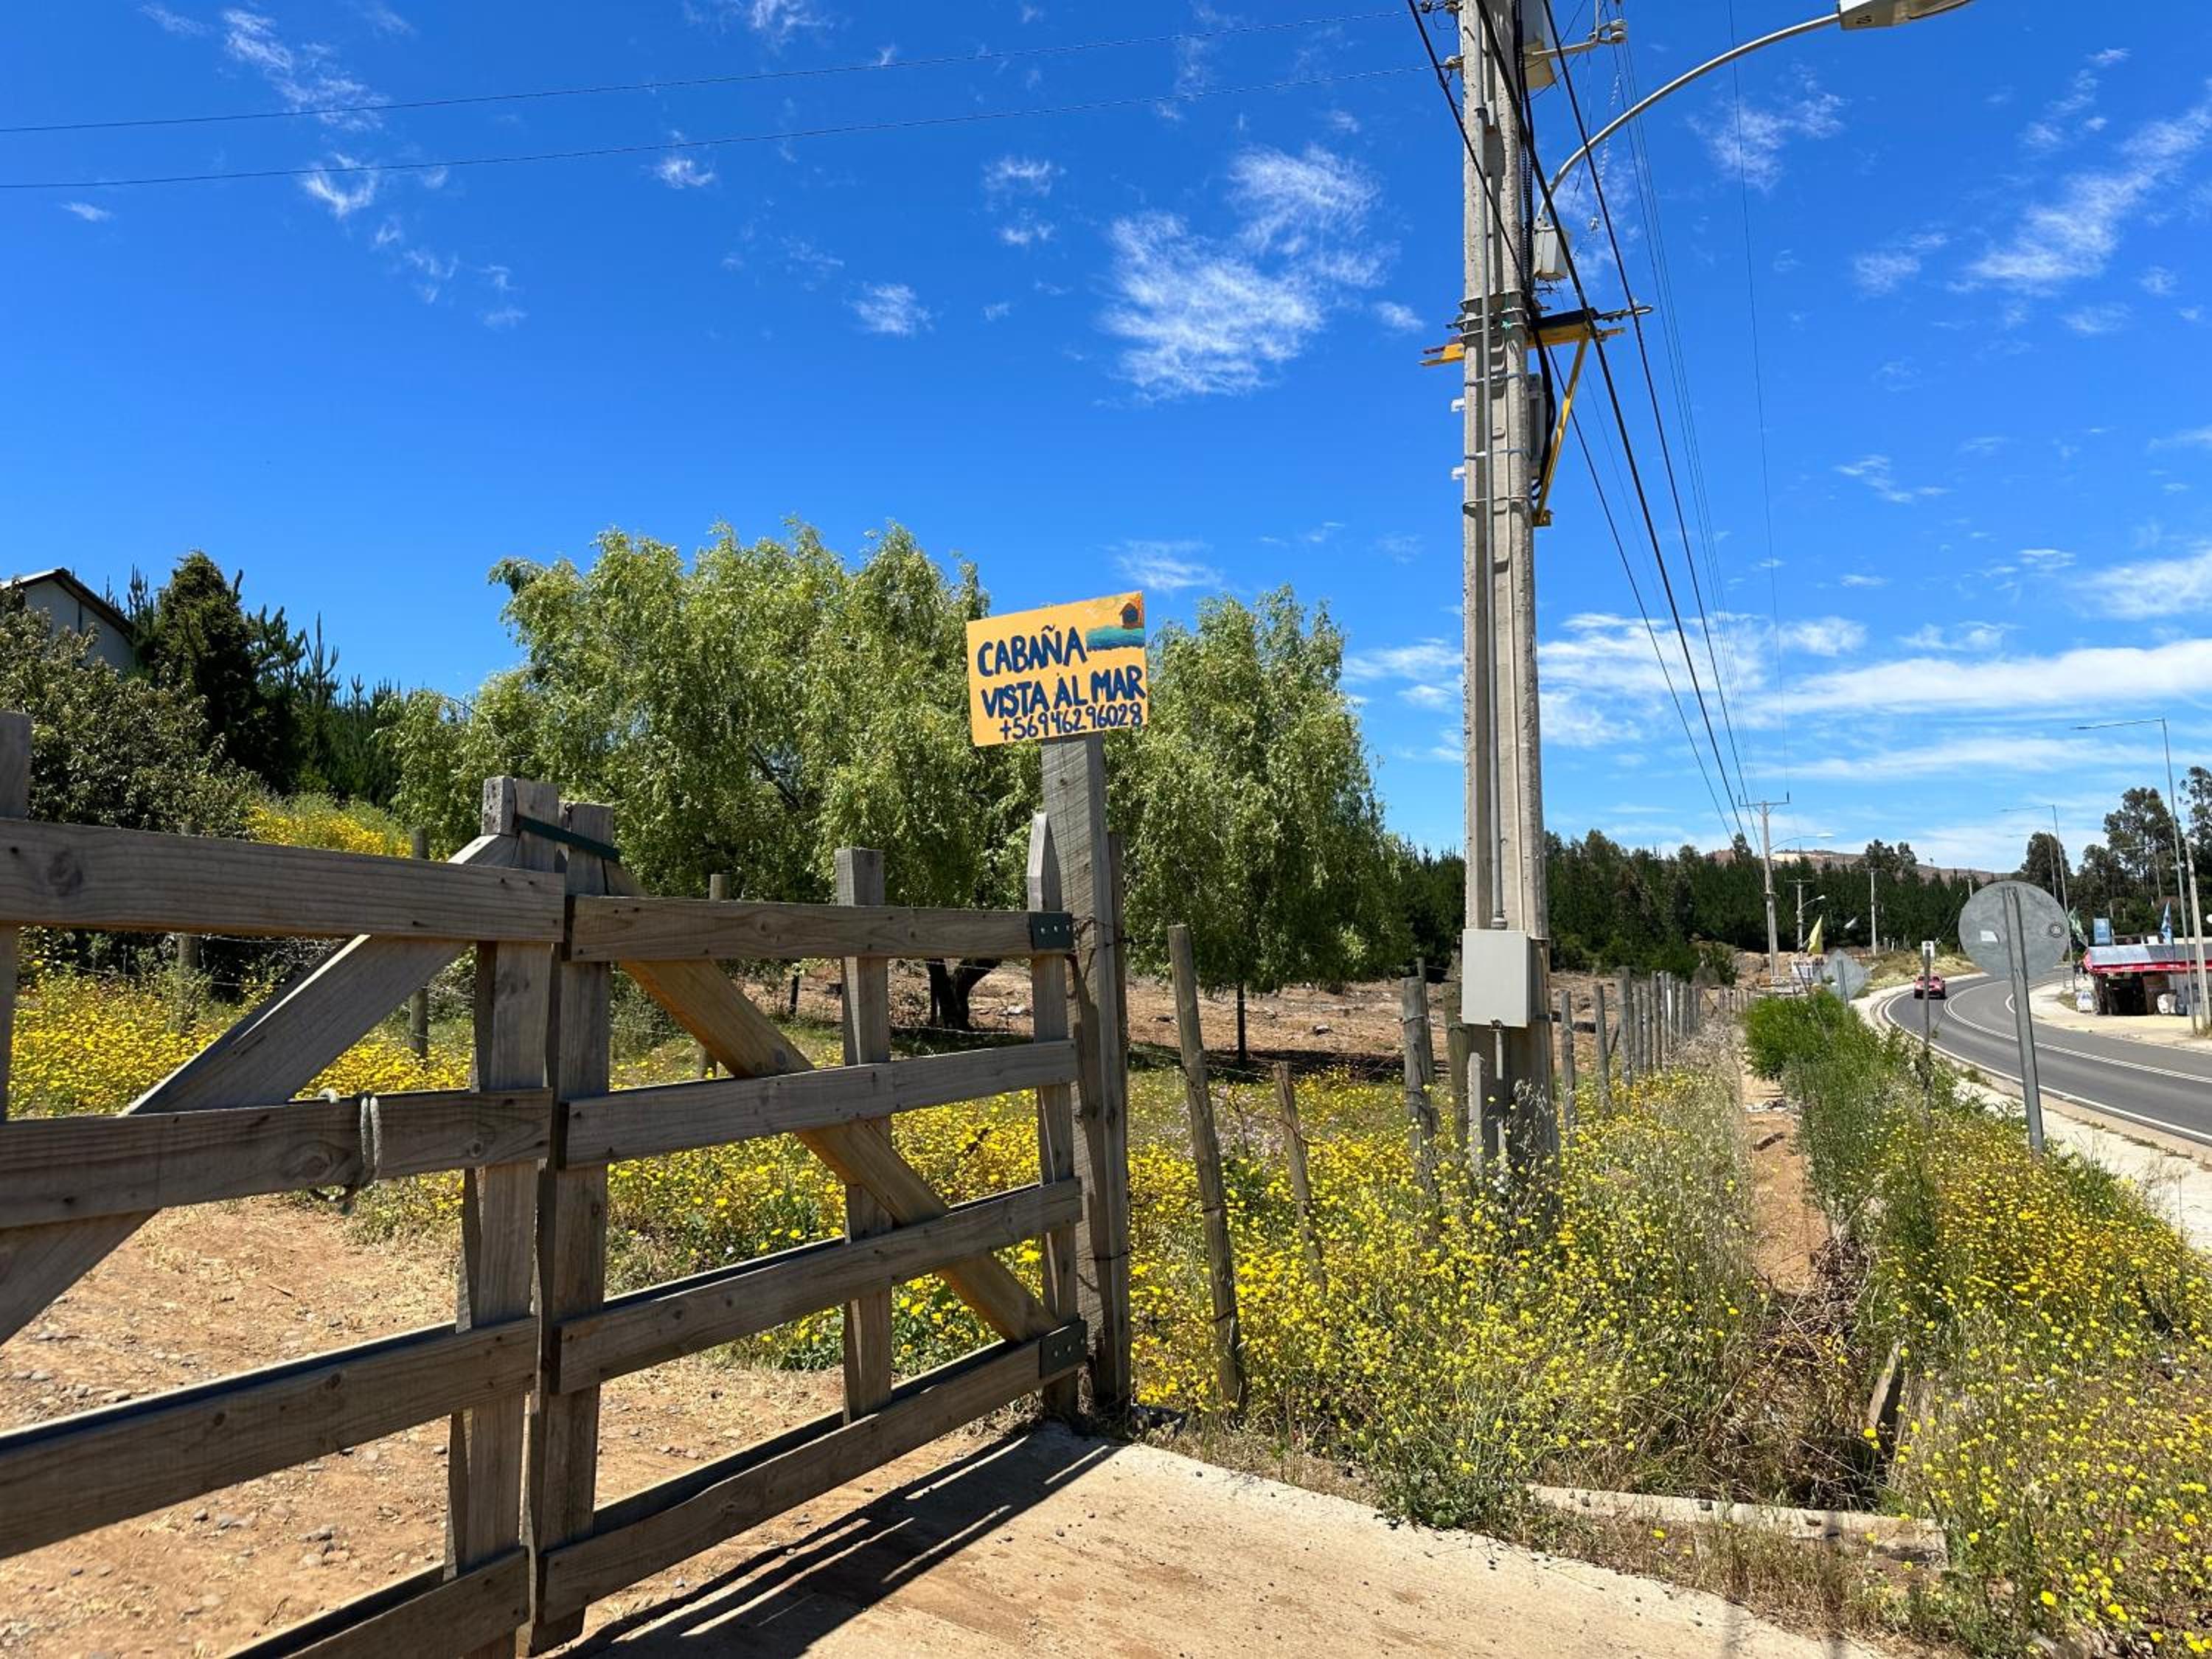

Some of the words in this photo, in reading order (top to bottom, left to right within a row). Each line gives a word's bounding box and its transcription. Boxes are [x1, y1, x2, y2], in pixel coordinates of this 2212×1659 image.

[978, 624, 1088, 677] CABAÑA
[981, 681, 1050, 718] VISTA
[1054, 675, 1088, 709] AL
[1091, 665, 1147, 703] MAR
